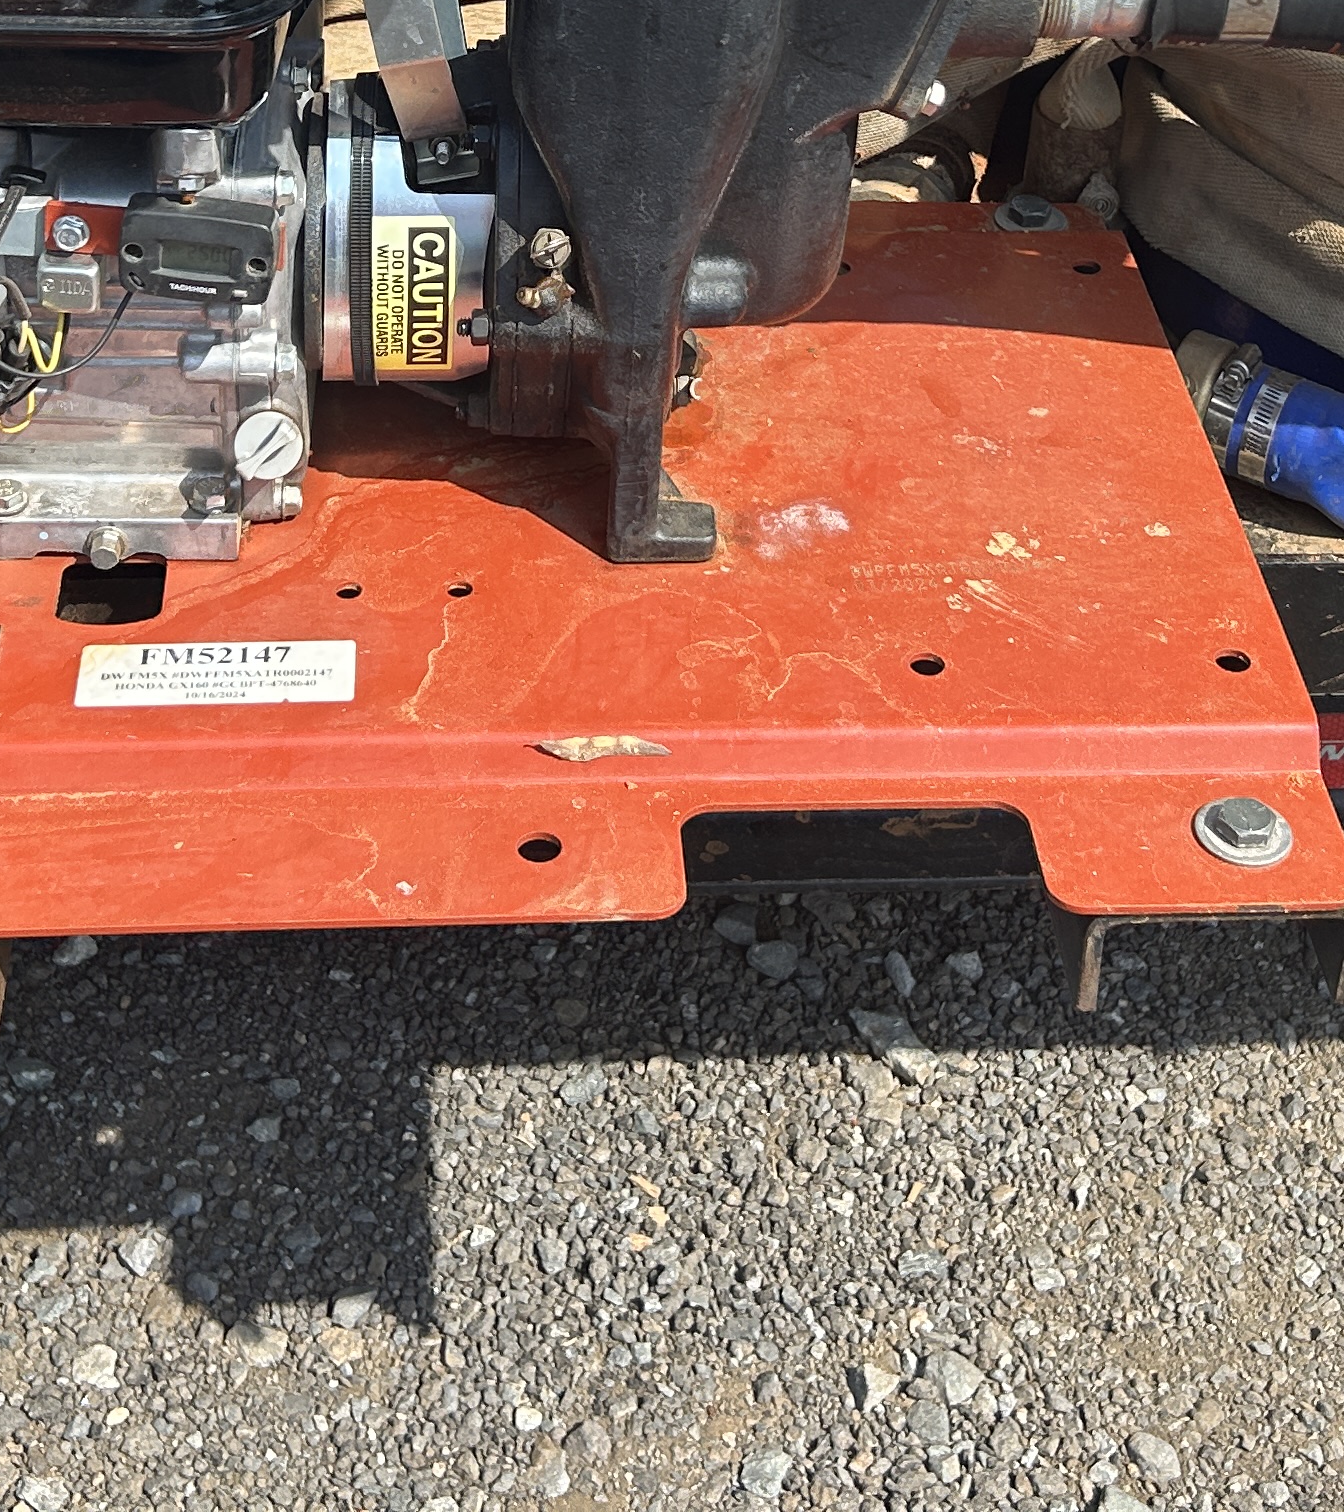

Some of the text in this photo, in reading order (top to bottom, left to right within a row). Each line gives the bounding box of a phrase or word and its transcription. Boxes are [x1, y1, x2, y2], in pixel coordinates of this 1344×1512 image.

[376, 244, 389, 357] WITHOUT GUARDS
[391, 249, 405, 355] DO NOT OPERATE
[411, 232, 446, 363] CAUTION
[140, 646, 292, 666] FM52147
[100, 671, 124, 681] DW
[129, 671, 168, 680] FM5X
[115, 681, 164, 690] HONDA
[168, 680, 209, 690] GX160
[184, 691, 246, 699] 10/16/2024
